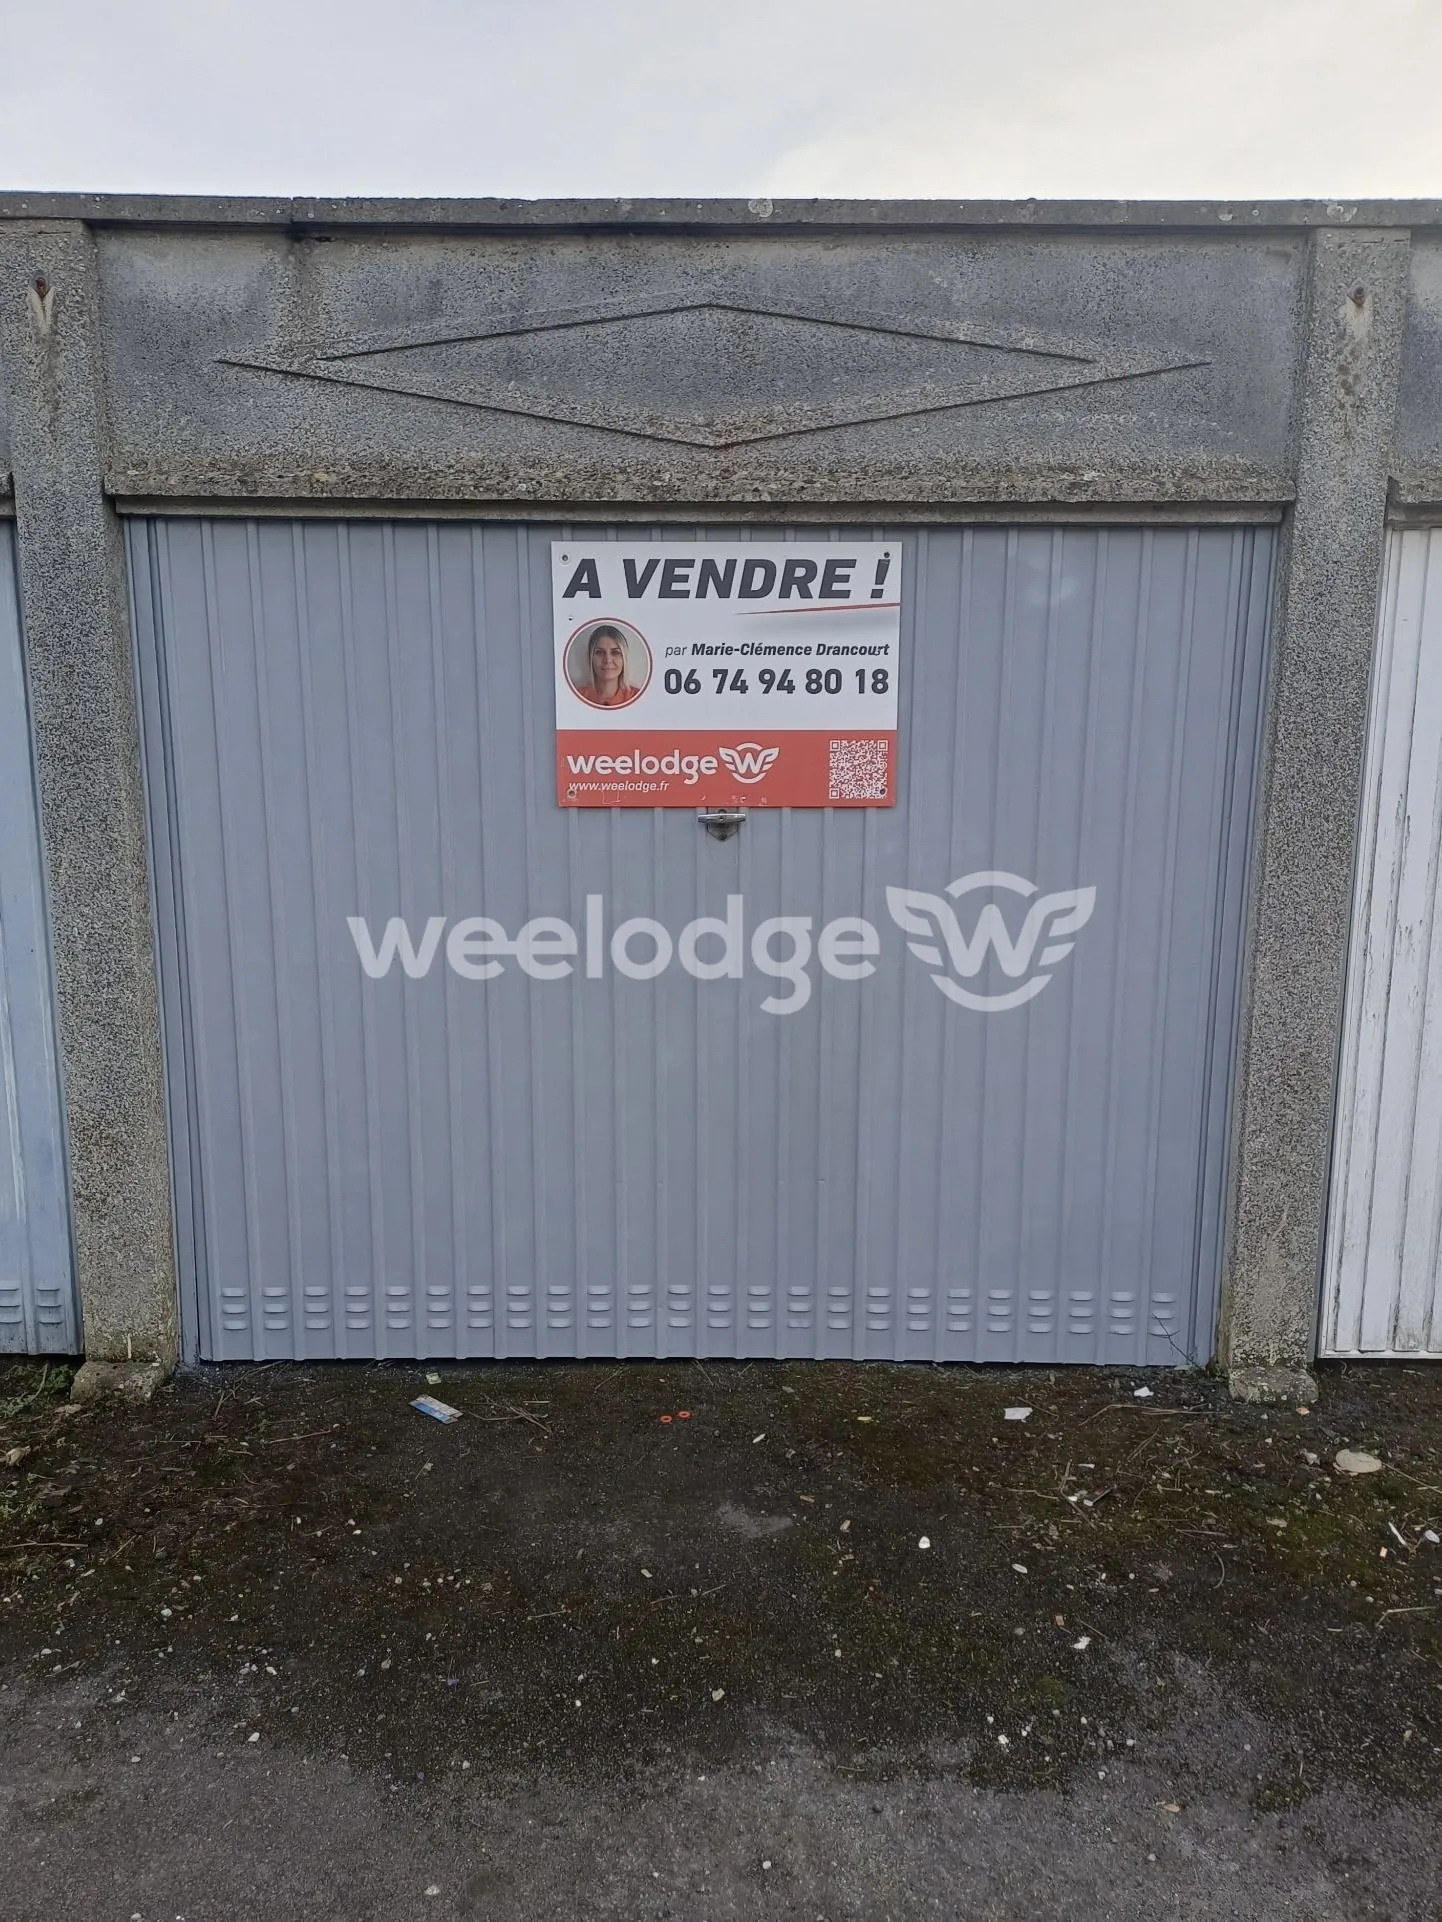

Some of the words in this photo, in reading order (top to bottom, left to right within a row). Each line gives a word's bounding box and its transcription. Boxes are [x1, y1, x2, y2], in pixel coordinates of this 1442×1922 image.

[562, 558, 602, 599] A
[622, 558, 857, 599] VENDRE
[870, 558, 891, 599] !
[664, 645, 687, 657] par
[691, 642, 812, 656] Marie-Clémence
[816, 643, 890, 656] Drancourt
[664, 668, 701, 694] 06
[712, 668, 748, 694] 74
[758, 668, 796, 694] 94
[805, 668, 842, 694] 80
[855, 668, 889, 694] 18
[567, 750, 718, 784] weelodge
[568, 781, 669, 791] www.weelodge.fr
